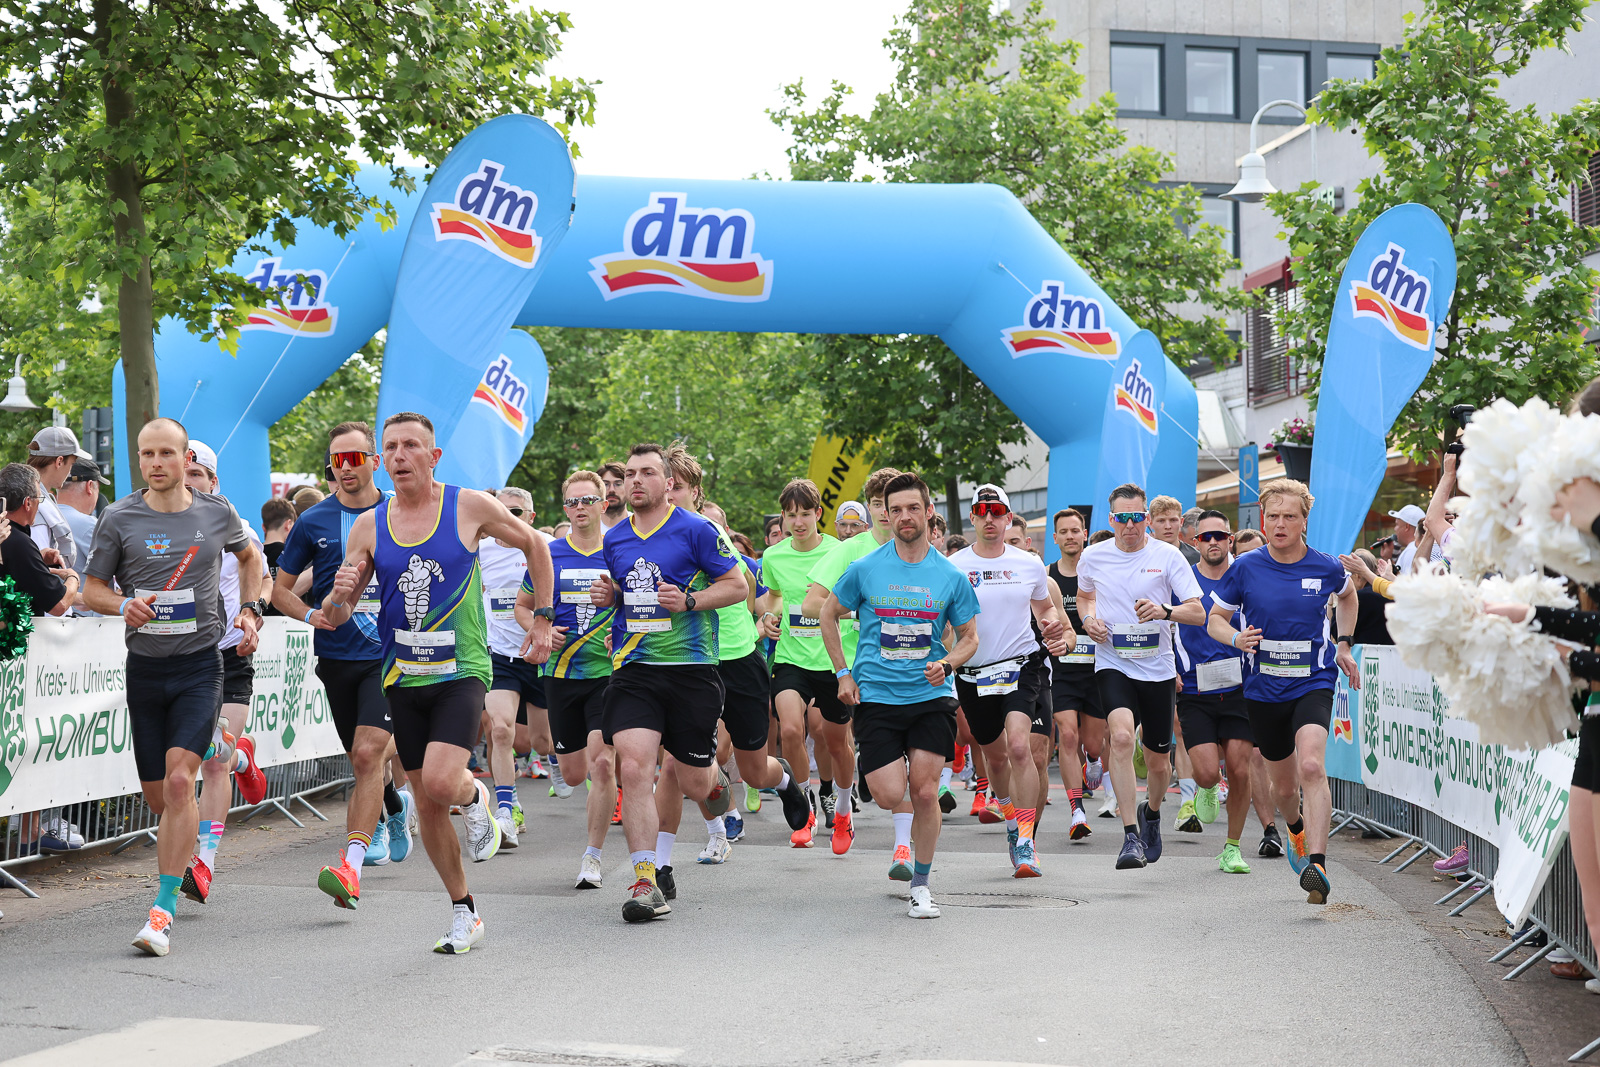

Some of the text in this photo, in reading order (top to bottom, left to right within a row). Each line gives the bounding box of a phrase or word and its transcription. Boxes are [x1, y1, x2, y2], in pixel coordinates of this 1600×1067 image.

[459, 166, 534, 230] dm
[631, 197, 747, 259] dm
[1370, 249, 1430, 314] dm
[1029, 285, 1101, 330] dm
[485, 359, 528, 409] dm
[1124, 363, 1152, 408] dm
[1243, 454, 1254, 497] P
[153, 605, 174, 614] Yves
[632, 605, 656, 614] Jeremy
[411, 646, 435, 655] Marc
[1269, 651, 1300, 660] Matthias
[36, 664, 67, 697] Kreis-
[70, 672, 79, 694] u.
[990, 672, 1010, 681] Martin
[245, 693, 279, 734] URG
[1335, 681, 1348, 719] dm
[33, 708, 133, 764] HOMBU
